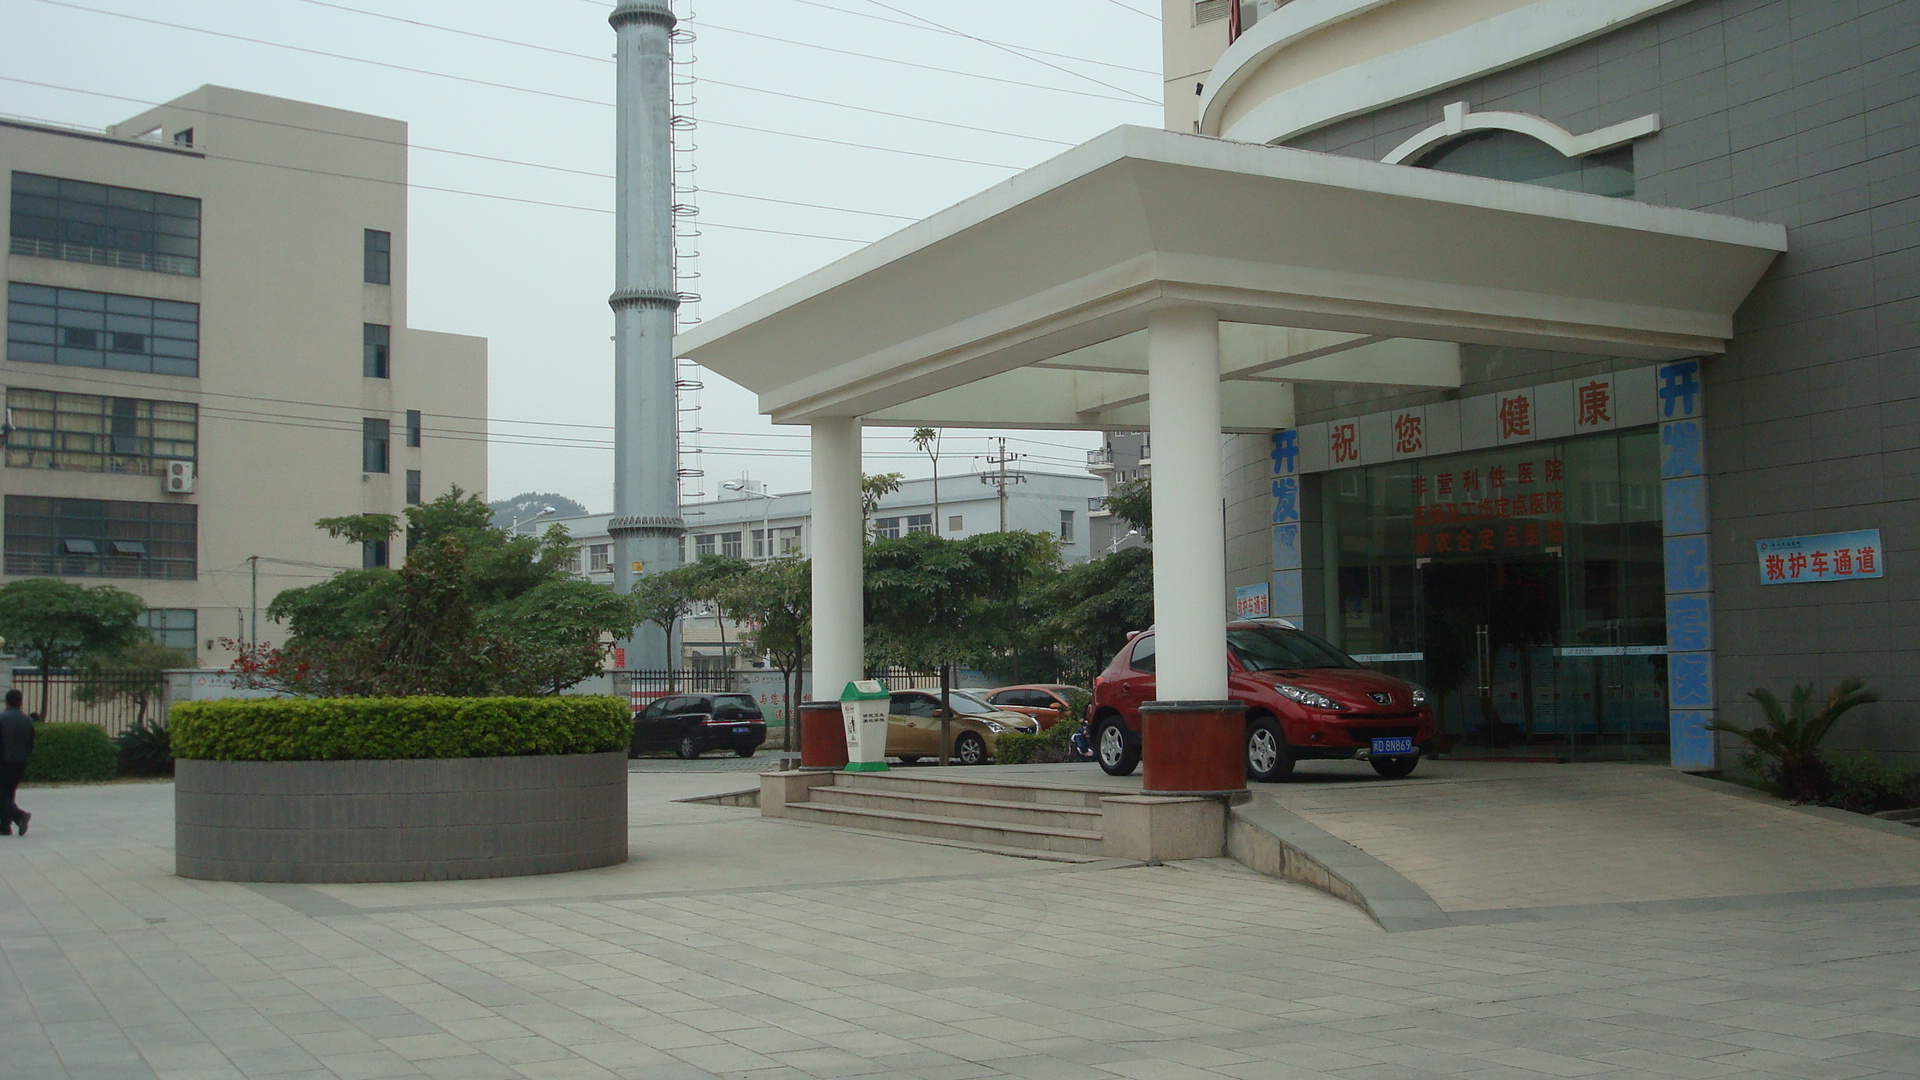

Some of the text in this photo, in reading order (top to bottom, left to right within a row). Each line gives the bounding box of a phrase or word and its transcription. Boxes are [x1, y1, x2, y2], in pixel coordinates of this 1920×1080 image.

[1331, 380, 1612, 464] 祝您健康
[1412, 459, 1563, 497] 非营利性医院
[1765, 546, 1876, 581] 救护车通道
